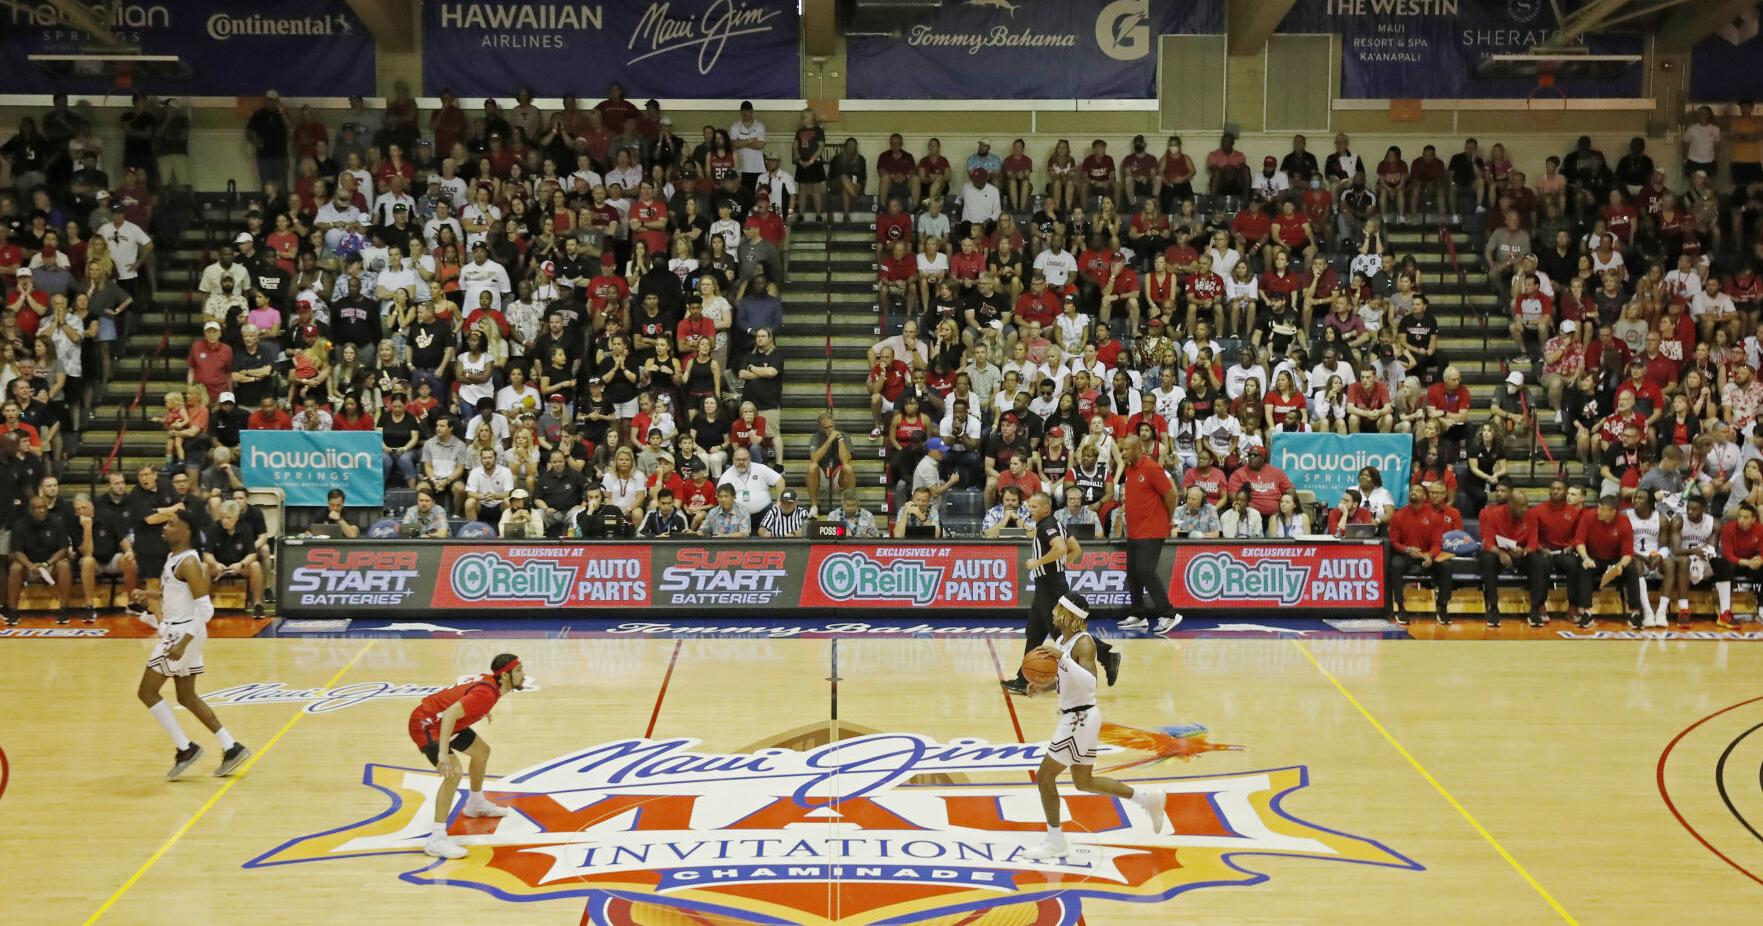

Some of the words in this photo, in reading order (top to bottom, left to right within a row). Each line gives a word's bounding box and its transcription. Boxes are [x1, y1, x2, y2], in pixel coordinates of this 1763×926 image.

[440, 3, 603, 30] HAWAIIAN
[1325, 0, 1367, 15] THE
[1371, 0, 1458, 16] WESTIN
[42, 30, 141, 42] SPRIGS
[206, 13, 332, 40] Continental
[1377, 23, 1406, 33] MAUI
[481, 33, 564, 49] AIRLINES
[628, 2, 695, 50] Maui
[698, 0, 781, 75] Jim
[907, 24, 985, 55] Tommy
[983, 25, 1076, 48] Bahama
[1353, 37, 1394, 48] RESORT
[1407, 37, 1428, 48] SPA
[250, 445, 372, 469] hawaiian
[1282, 447, 1401, 472] hawaiian
[273, 471, 350, 480] SPRINGS
[1303, 472, 1356, 482] SPRIN
[819, 526, 836, 536] POSS
[306, 548, 418, 570] SUPER
[508, 547, 569, 557] EXCLUSIVELY
[570, 547, 585, 557] AT
[675, 547, 786, 569] SUPER
[875, 547, 936, 557] EXCLUSIVELY
[938, 547, 952, 557] AT
[1066, 551, 1127, 570] UPE
[1241, 547, 1302, 557] EXCLUSIVELY
[1303, 547, 1317, 557] AT
[453, 554, 575, 603] O'Reilly
[584, 558, 641, 579] AUTO
[821, 553, 943, 603] O'Reilly
[951, 558, 1007, 579] AUTO
[1187, 553, 1310, 603] O'Reilly
[1316, 558, 1374, 579] AUTO
[288, 567, 419, 592] START
[659, 567, 787, 592] START
[300, 593, 403, 605] BATTERIES
[578, 580, 647, 601] PARTS
[671, 592, 772, 604] BATTERIES
[944, 580, 1013, 601] PARTS
[1311, 580, 1380, 601] PARTS
[606, 623, 802, 637] Tommy
[201, 684, 313, 703] Maui
[509, 739, 777, 784] Maui
[792, 734, 1052, 809] Jim
[673, 867, 995, 882] CHAMINADE
